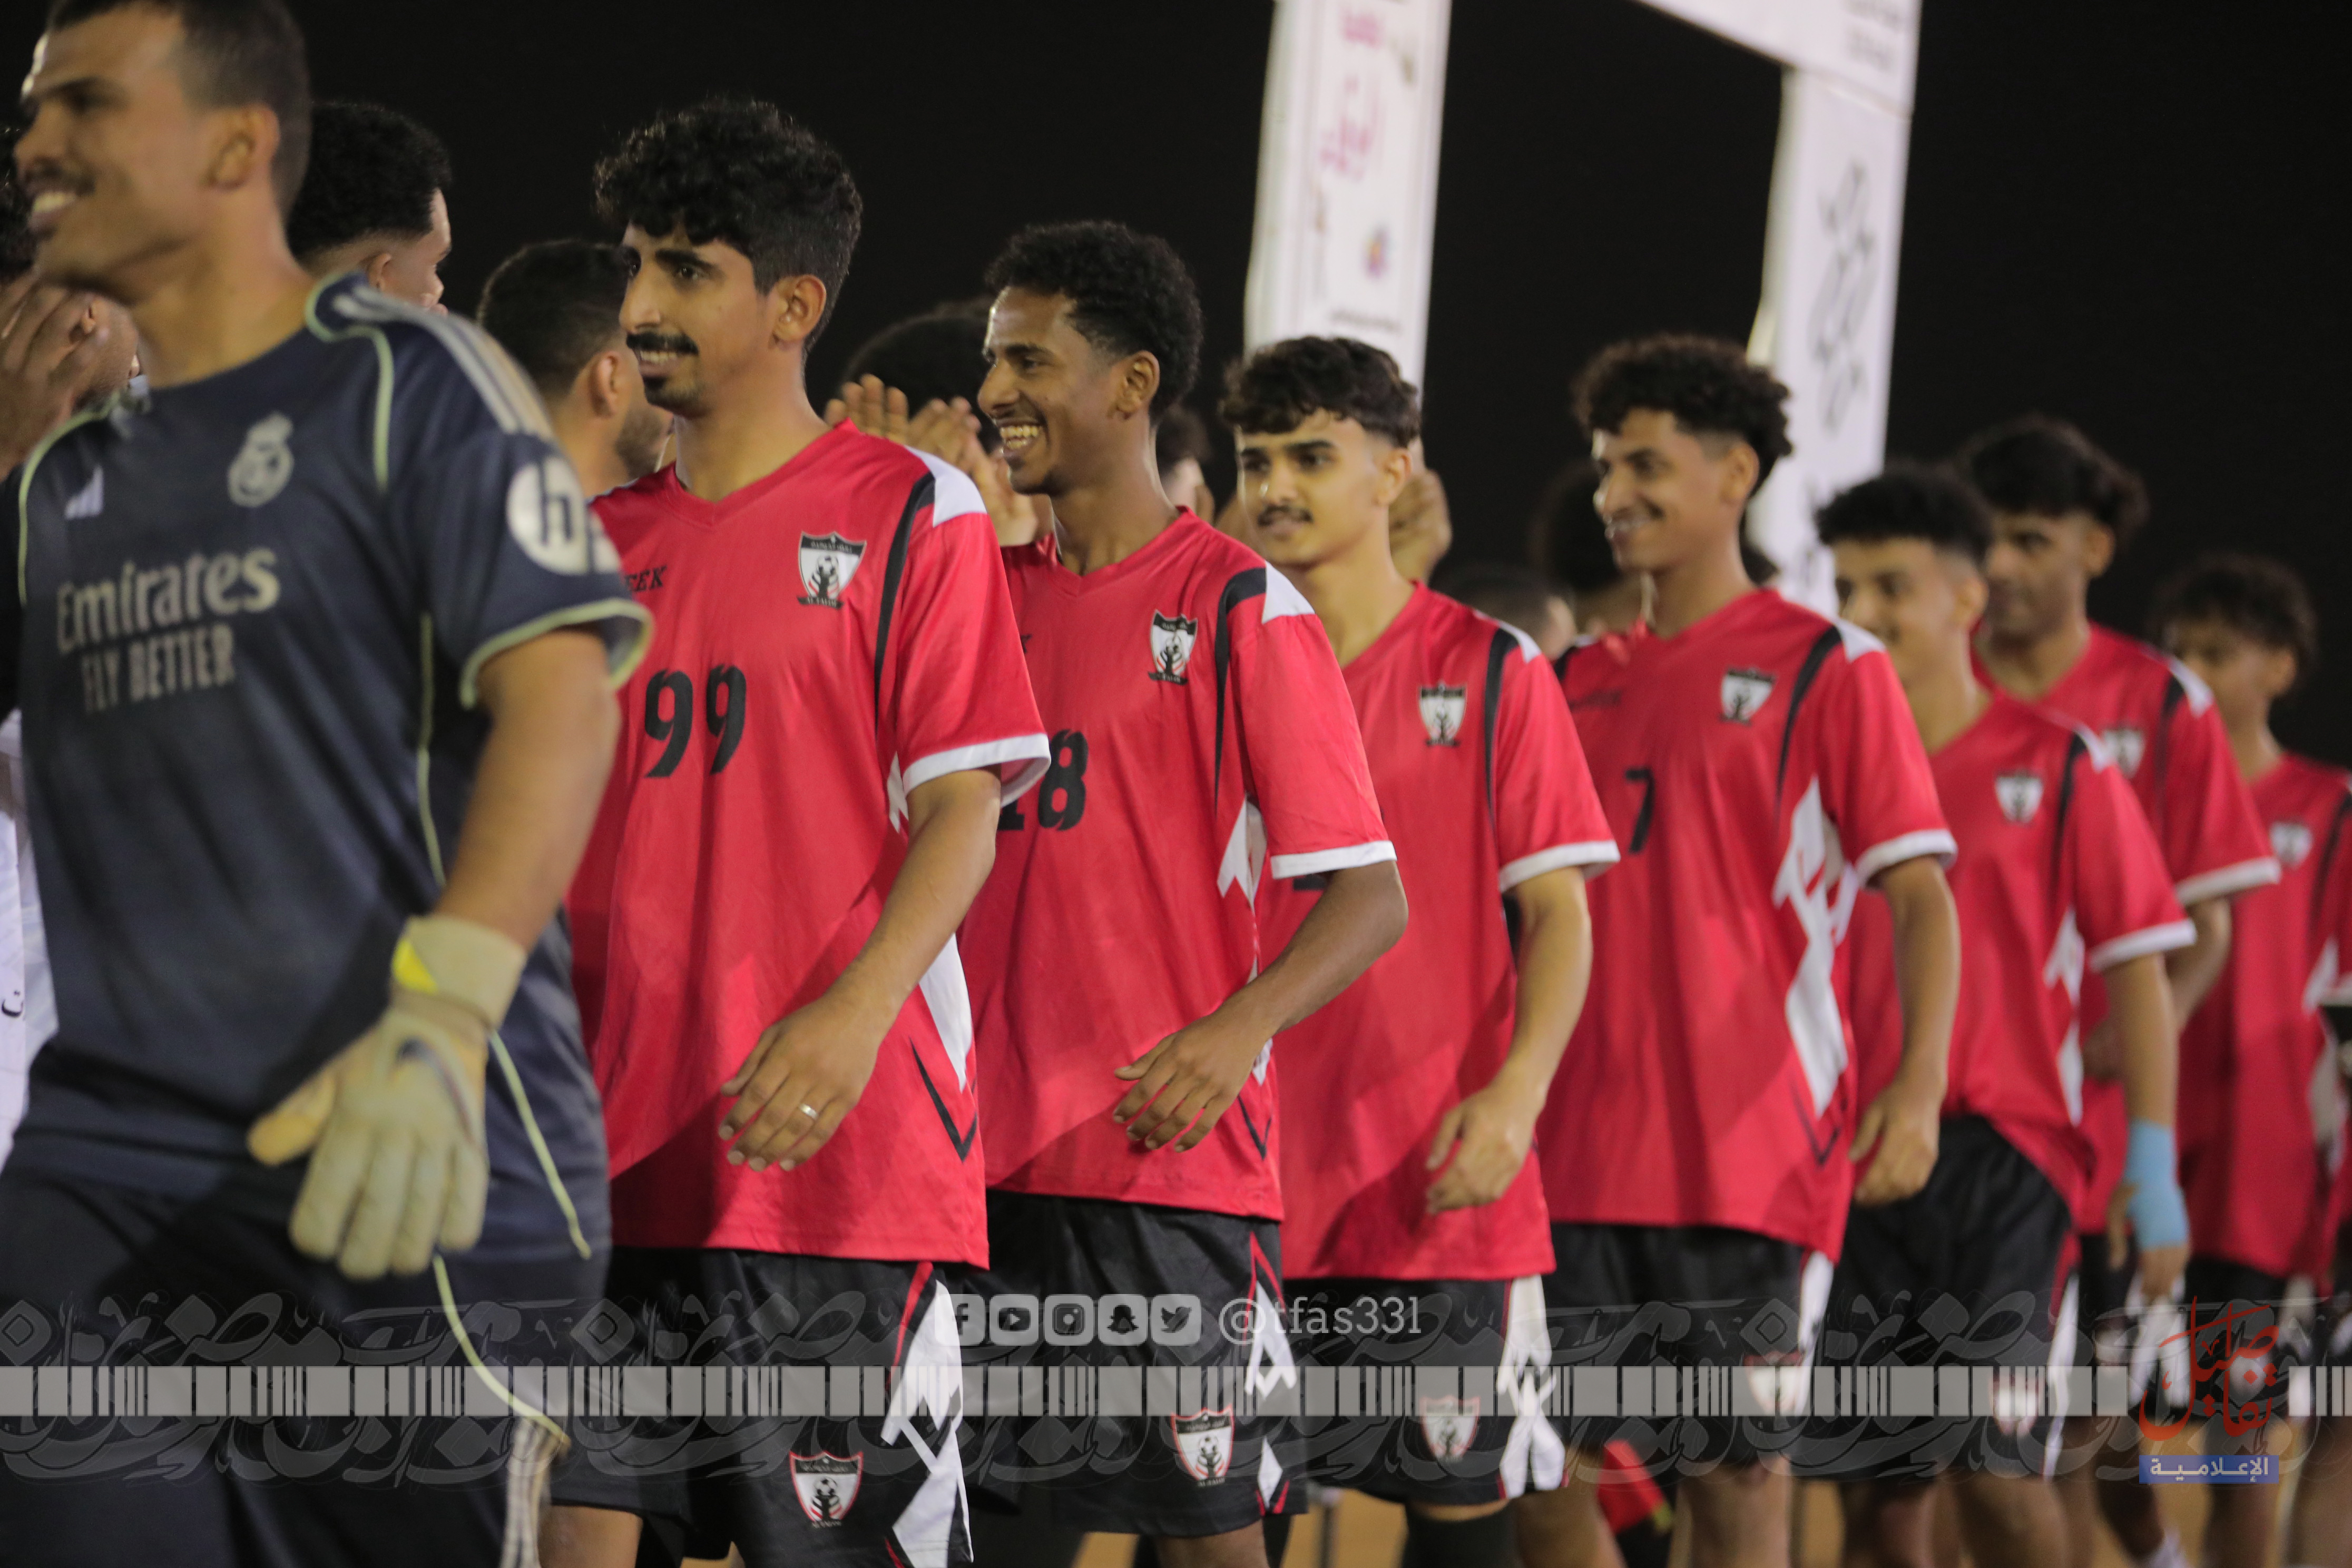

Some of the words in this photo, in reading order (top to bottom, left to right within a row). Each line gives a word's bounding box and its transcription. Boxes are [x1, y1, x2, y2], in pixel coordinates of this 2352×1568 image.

[57, 548, 281, 656] Emirates
[81, 648, 121, 713] FLY
[129, 623, 235, 702] BETTER
[644, 663, 747, 779] 99
[1625, 767, 1655, 855] 7
